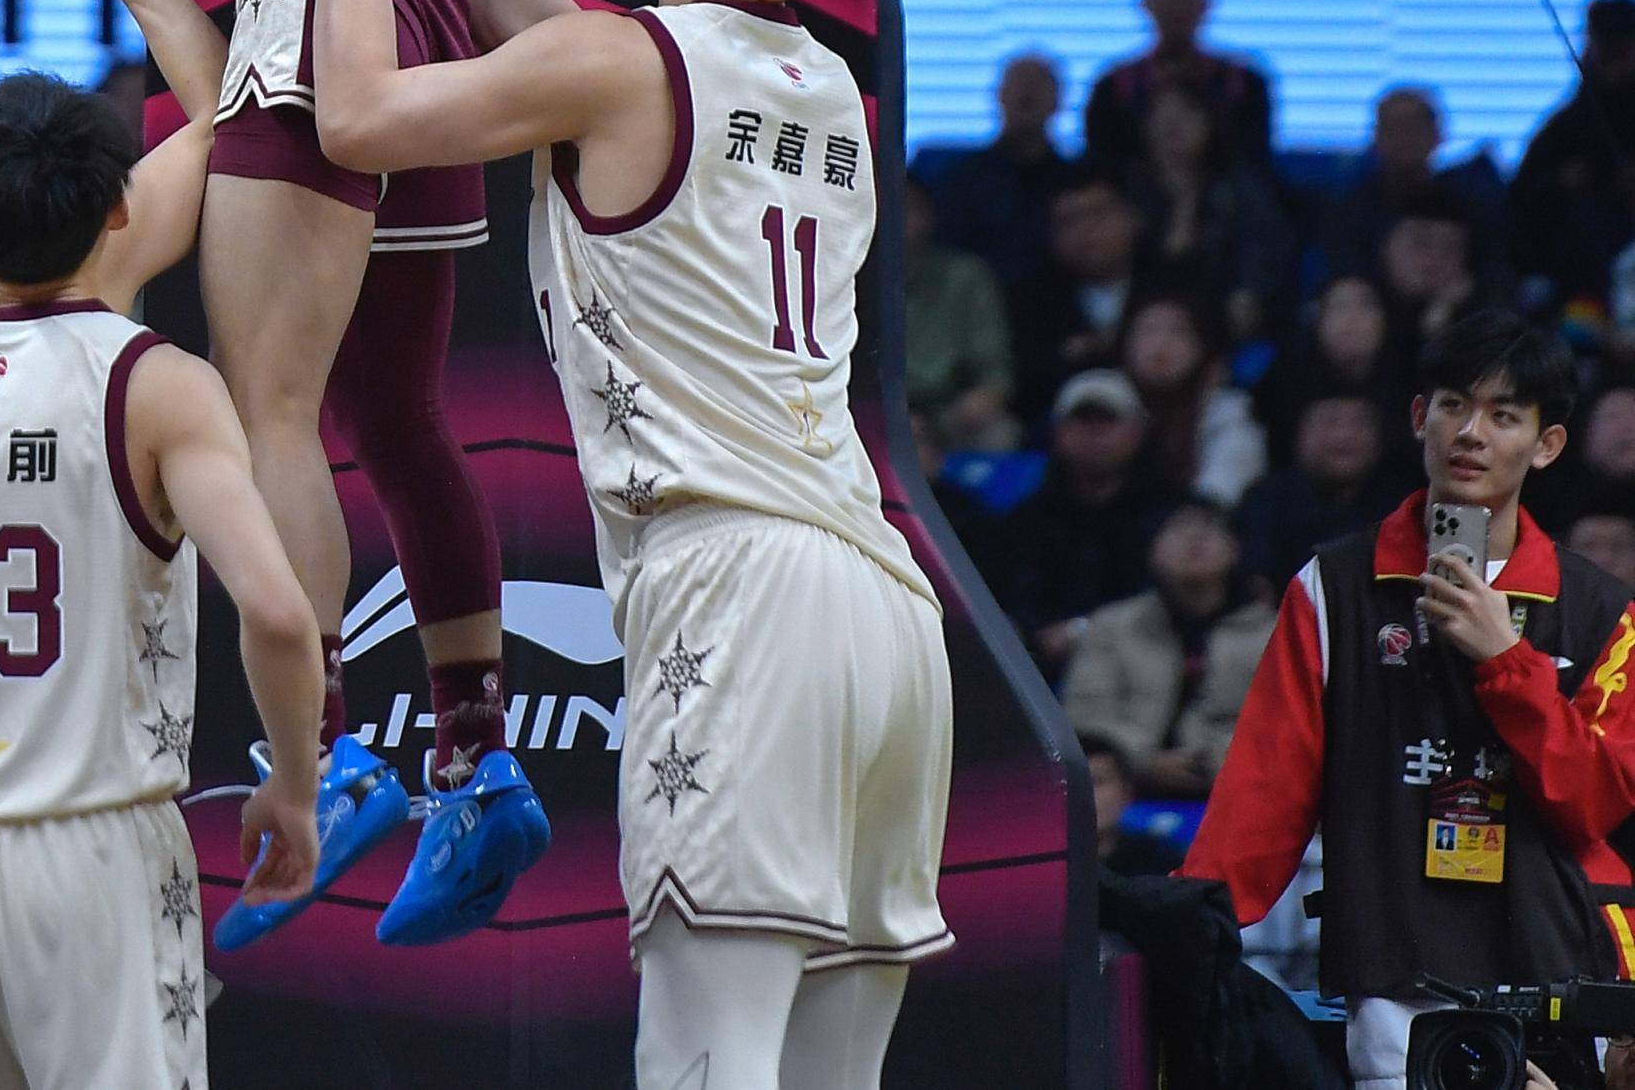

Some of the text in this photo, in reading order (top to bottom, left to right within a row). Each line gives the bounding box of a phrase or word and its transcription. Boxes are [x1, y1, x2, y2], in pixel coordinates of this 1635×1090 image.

[725, 108, 860, 191] 余嘉豪
[761, 203, 831, 360] 11
